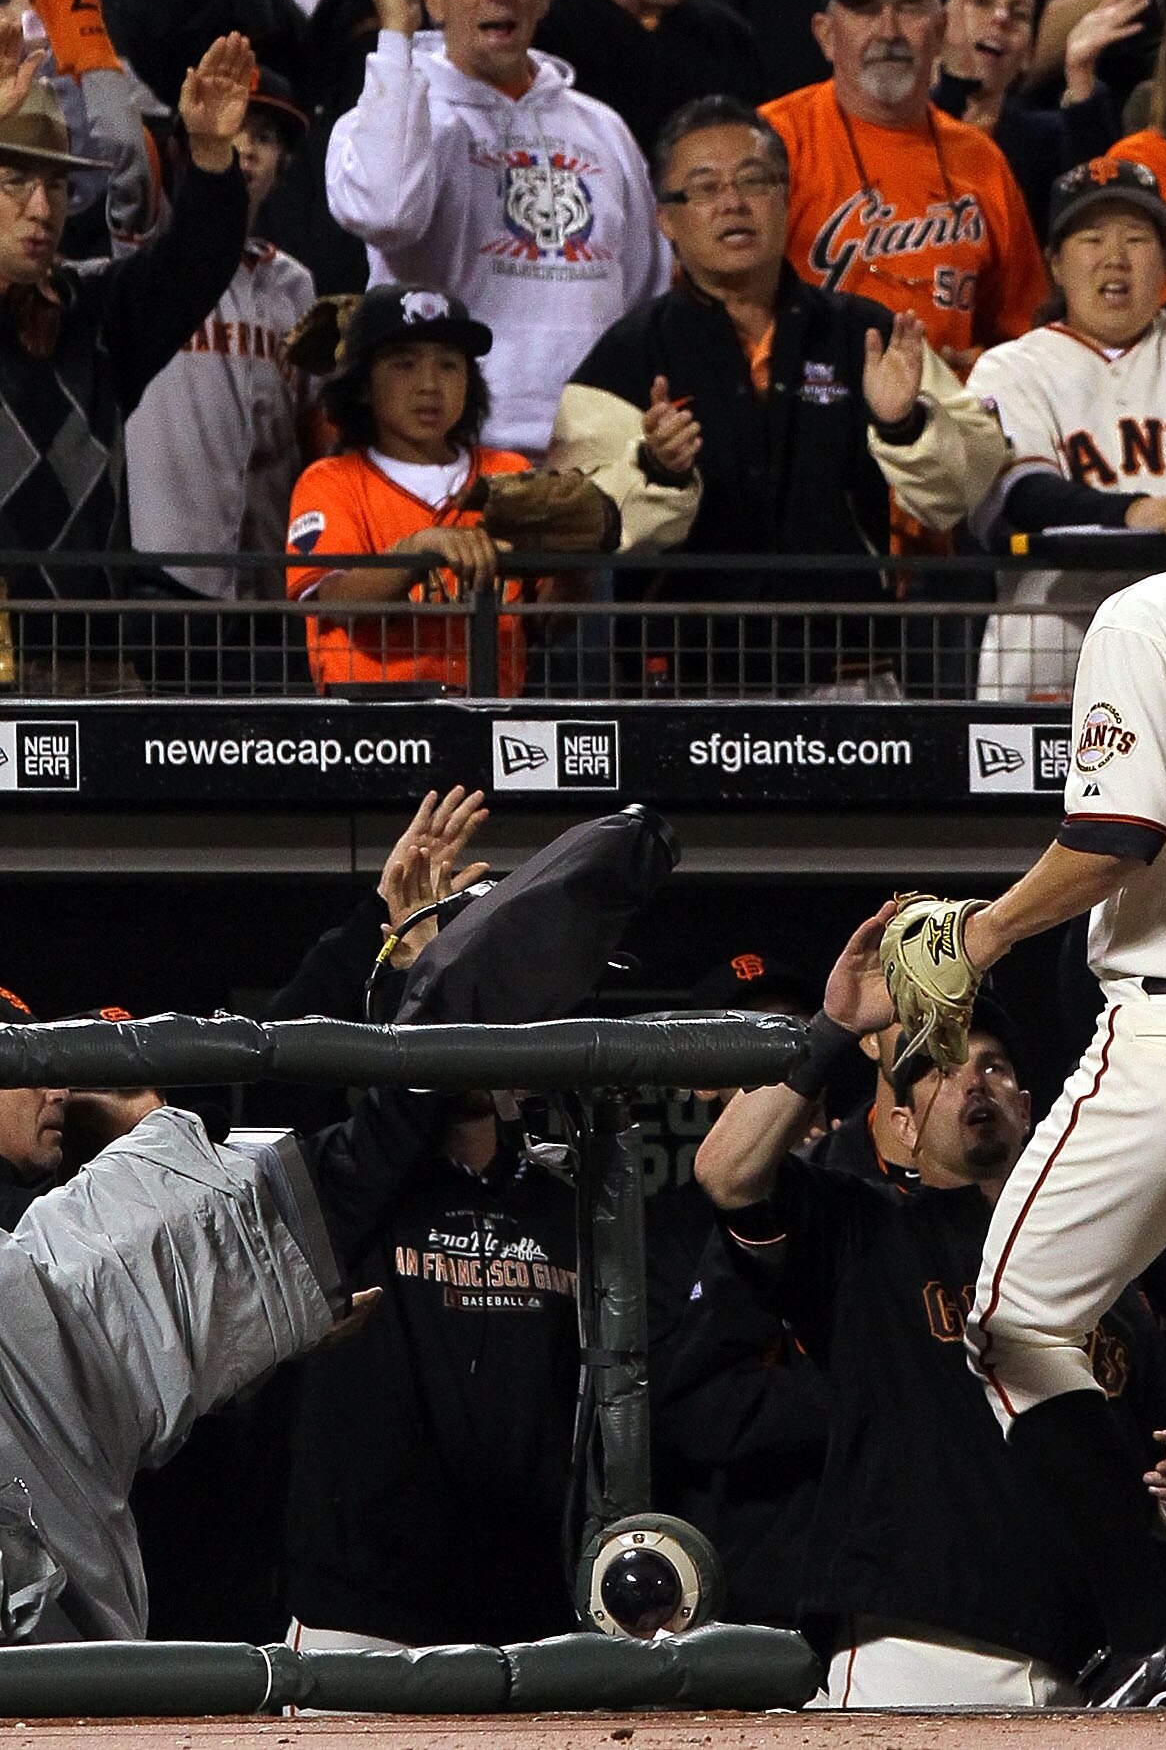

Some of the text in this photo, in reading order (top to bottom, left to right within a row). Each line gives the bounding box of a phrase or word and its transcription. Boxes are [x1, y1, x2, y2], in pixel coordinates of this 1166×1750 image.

[808, 188, 987, 292] Giants
[24, 736, 69, 755] NEW
[563, 736, 609, 755] NEW
[689, 732, 913, 773] sfgiants.com
[1040, 739, 1072, 757] NE
[144, 738, 431, 773] neweracap.com
[25, 757, 70, 776] ERA
[565, 756, 609, 776] ERA
[1040, 759, 1069, 777] ER
[532, 1262, 577, 1298] GIANT
[461, 1296, 524, 1307] BASEBALL
